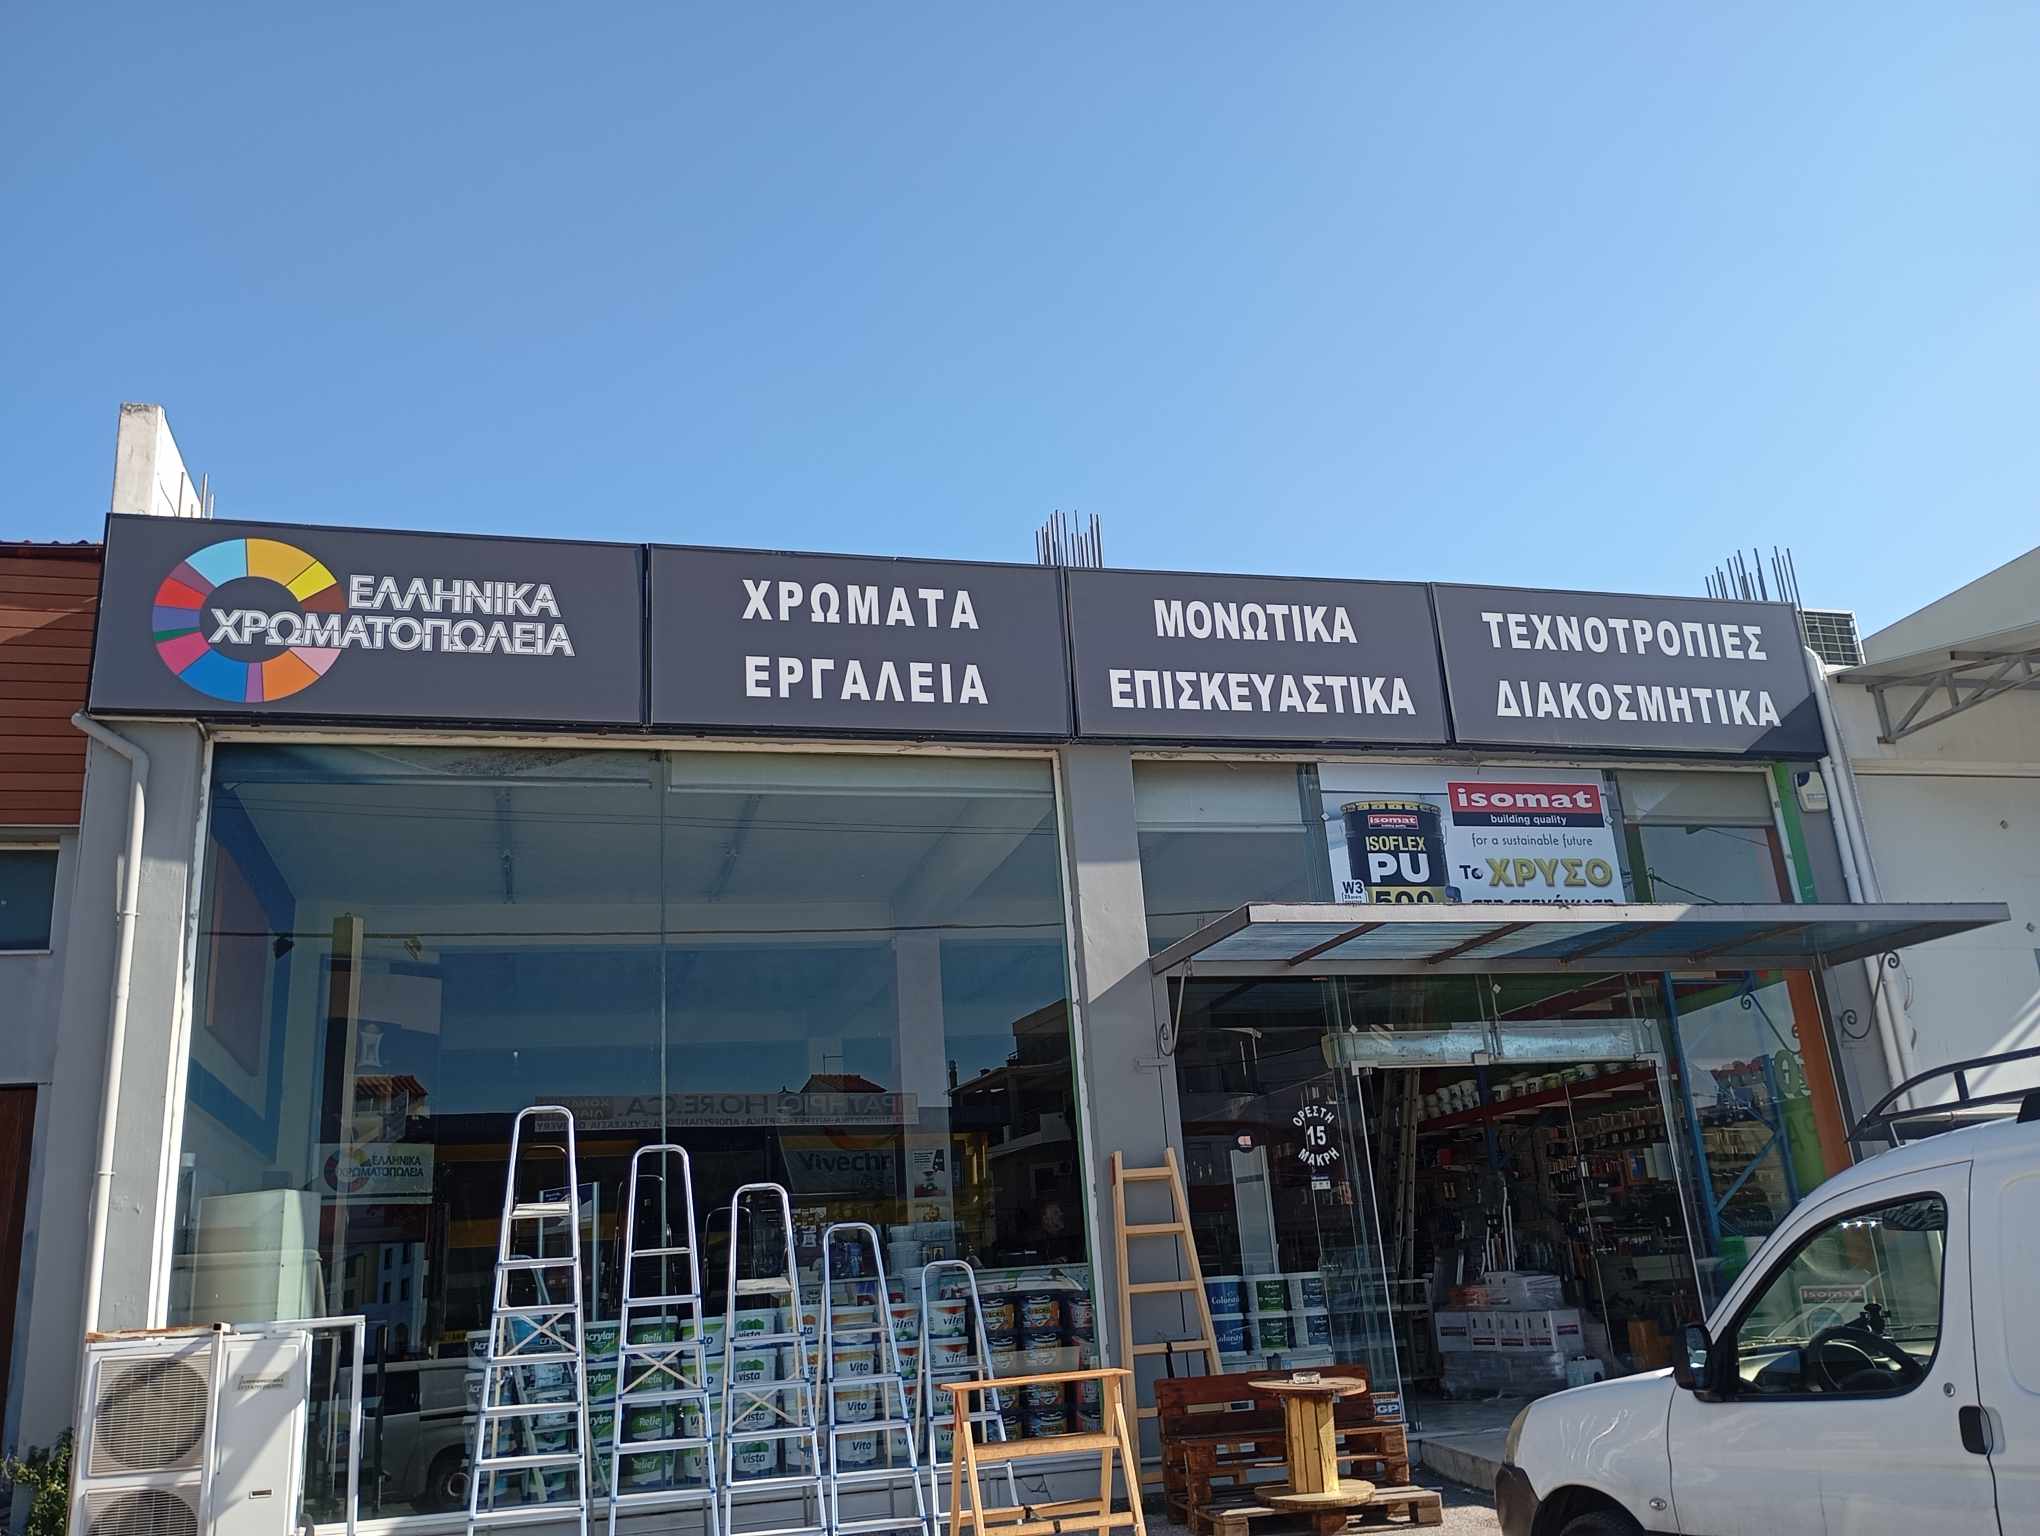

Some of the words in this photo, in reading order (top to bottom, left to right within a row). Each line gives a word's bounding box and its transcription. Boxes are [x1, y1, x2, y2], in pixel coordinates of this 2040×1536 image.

[348, 574, 561, 618] ΕΛΛΗΝΙΚΑ
[742, 579, 979, 630] ΧΡΩΜΑΤΑ
[208, 608, 575, 657] ΧΡΩΜΑΤΟΠΩΛΕΙΑ
[1153, 599, 1357, 644] ΜΟΝΩΤΙΚΑ
[1481, 611, 1767, 660] ΤΕΧΝΟΤΡΟΠΙΕΣ
[744, 655, 989, 704] ΕΡΓΑΛΕΙΑ
[1108, 668, 1416, 715] ΕΠΙΣΚΕΥΑΣΤΙΚΑ
[1496, 679, 1781, 728] ΔΙΑΚΟΣΜΗΤΙΚΑ
[1457, 788, 1593, 809] isomat
[1369, 816, 1416, 825] isomat
[1491, 814, 1531, 826] building
[1534, 814, 1567, 827] quality
[1365, 836, 1425, 851] ISOFLEX
[1472, 833, 1488, 848] for
[1491, 837, 1498, 846] a
[1502, 832, 1558, 847] sustainable
[1562, 832, 1593, 848] future
[1368, 853, 1430, 883] PU
[1485, 858, 1613, 889] ΧΡΥΣΟ
[1342, 881, 1363, 894] W3
[1292, 1105, 1335, 1127] ΟΡΕΣΤΗ
[1307, 1125, 1327, 1146] 15
[372, 1155, 421, 1166] ΕΛΛΗΝΙΚΑ
[1297, 1147, 1340, 1167] ΜΑΚΡΗ
